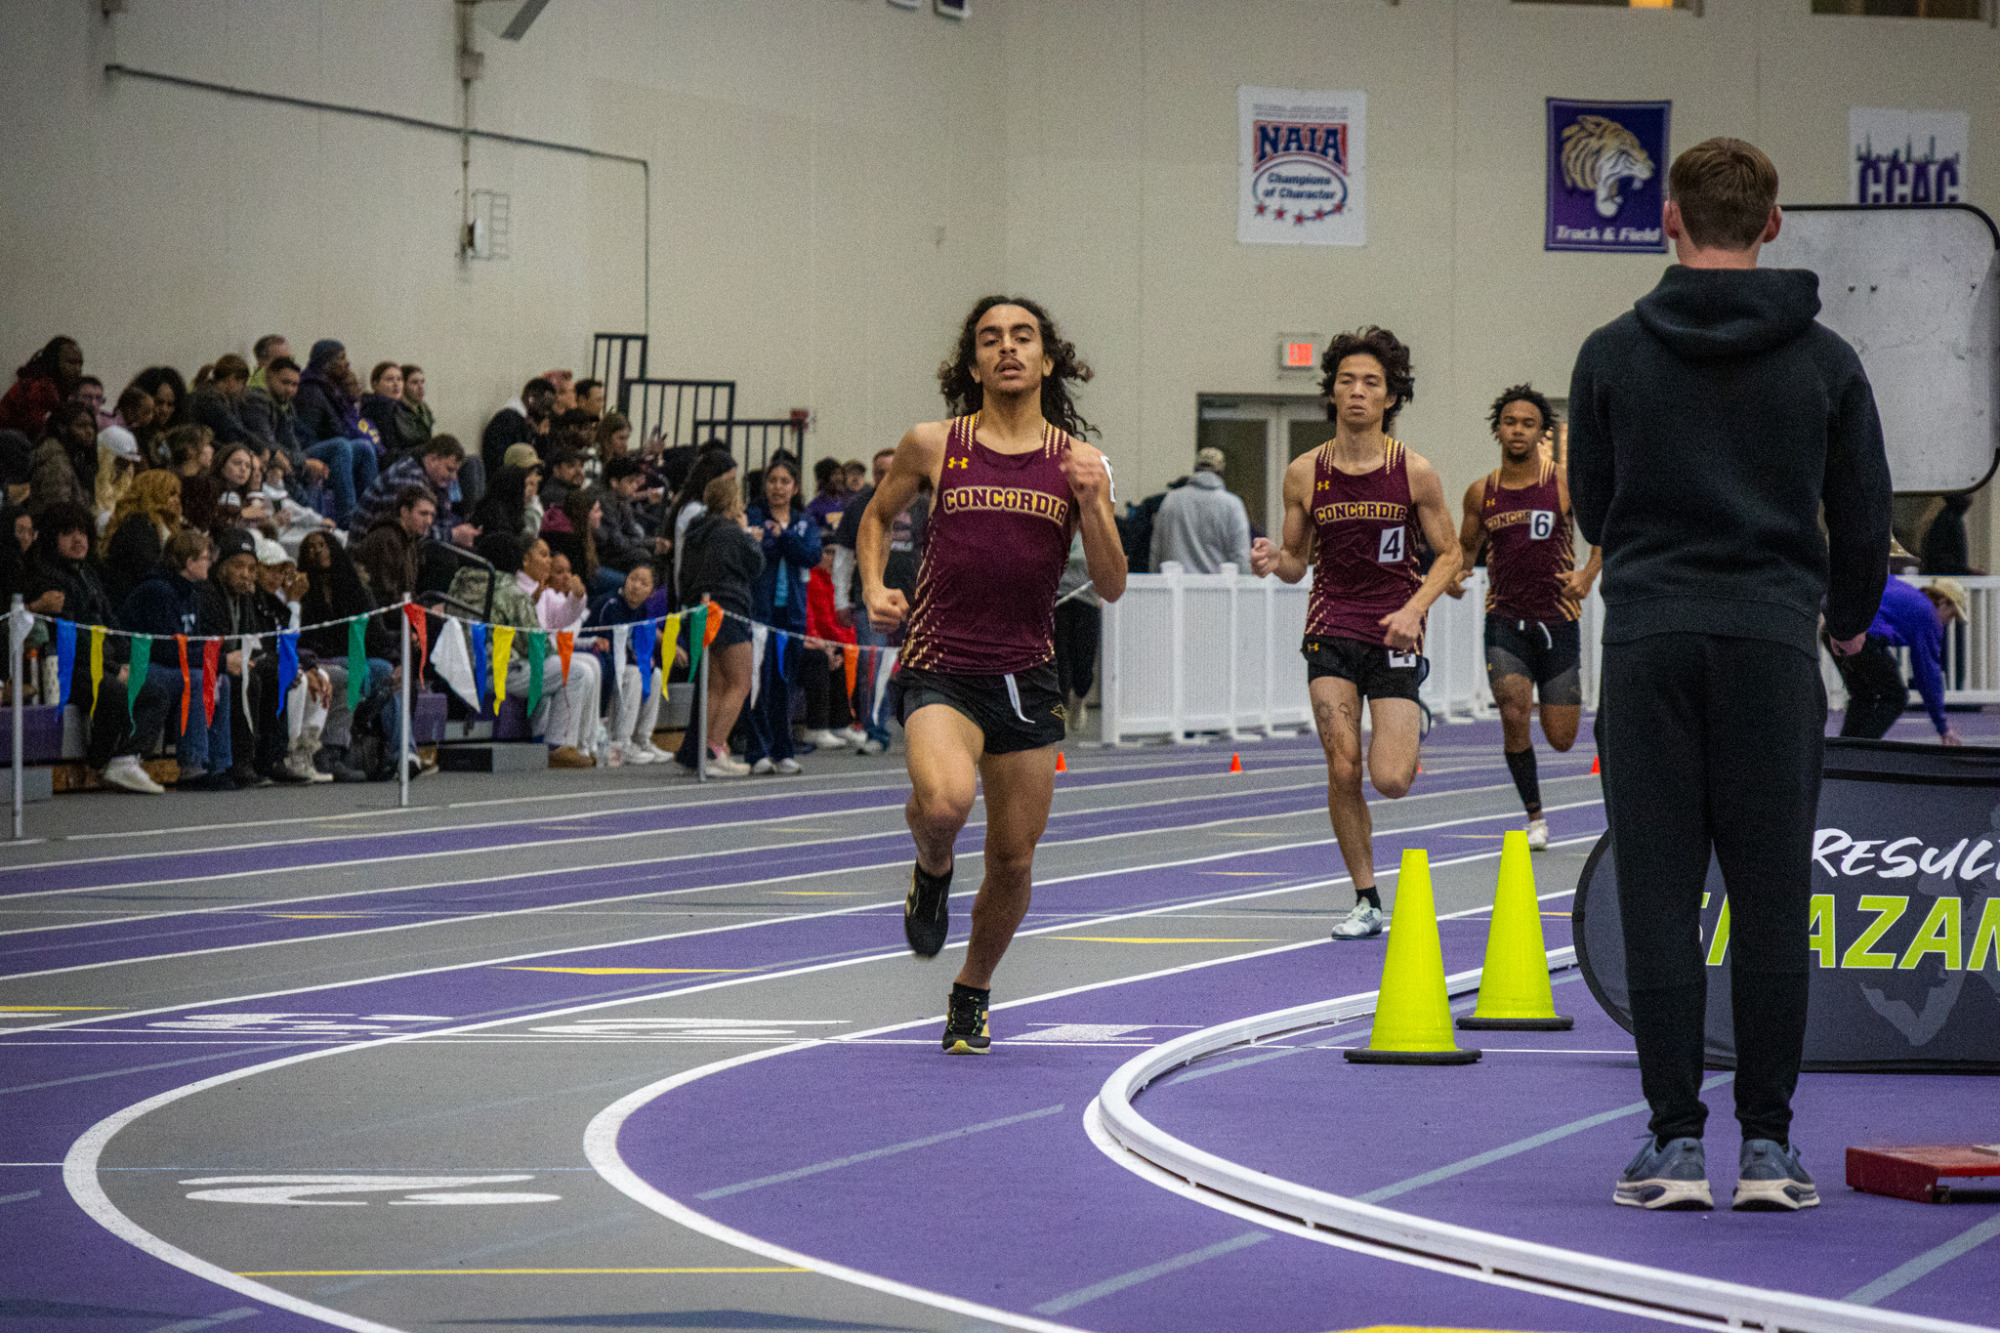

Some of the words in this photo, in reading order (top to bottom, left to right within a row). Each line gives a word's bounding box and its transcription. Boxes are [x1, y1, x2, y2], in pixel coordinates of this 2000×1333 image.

[1258, 125, 1342, 165] NAIA
[1267, 173, 1332, 186] Champions
[1859, 158, 1960, 205] CCAC
[1263, 187, 1276, 198] of
[1279, 187, 1336, 200] Character
[1556, 225, 1599, 241] Track
[1602, 227, 1616, 241] &
[1618, 227, 1661, 242] Field
[943, 486, 1069, 526] CONCORDIA
[1314, 502, 1408, 525] CONCORDIA
[1534, 513, 1550, 537] 6
[1382, 530, 1401, 559] 4
[1812, 828, 2000, 881] RESUL
